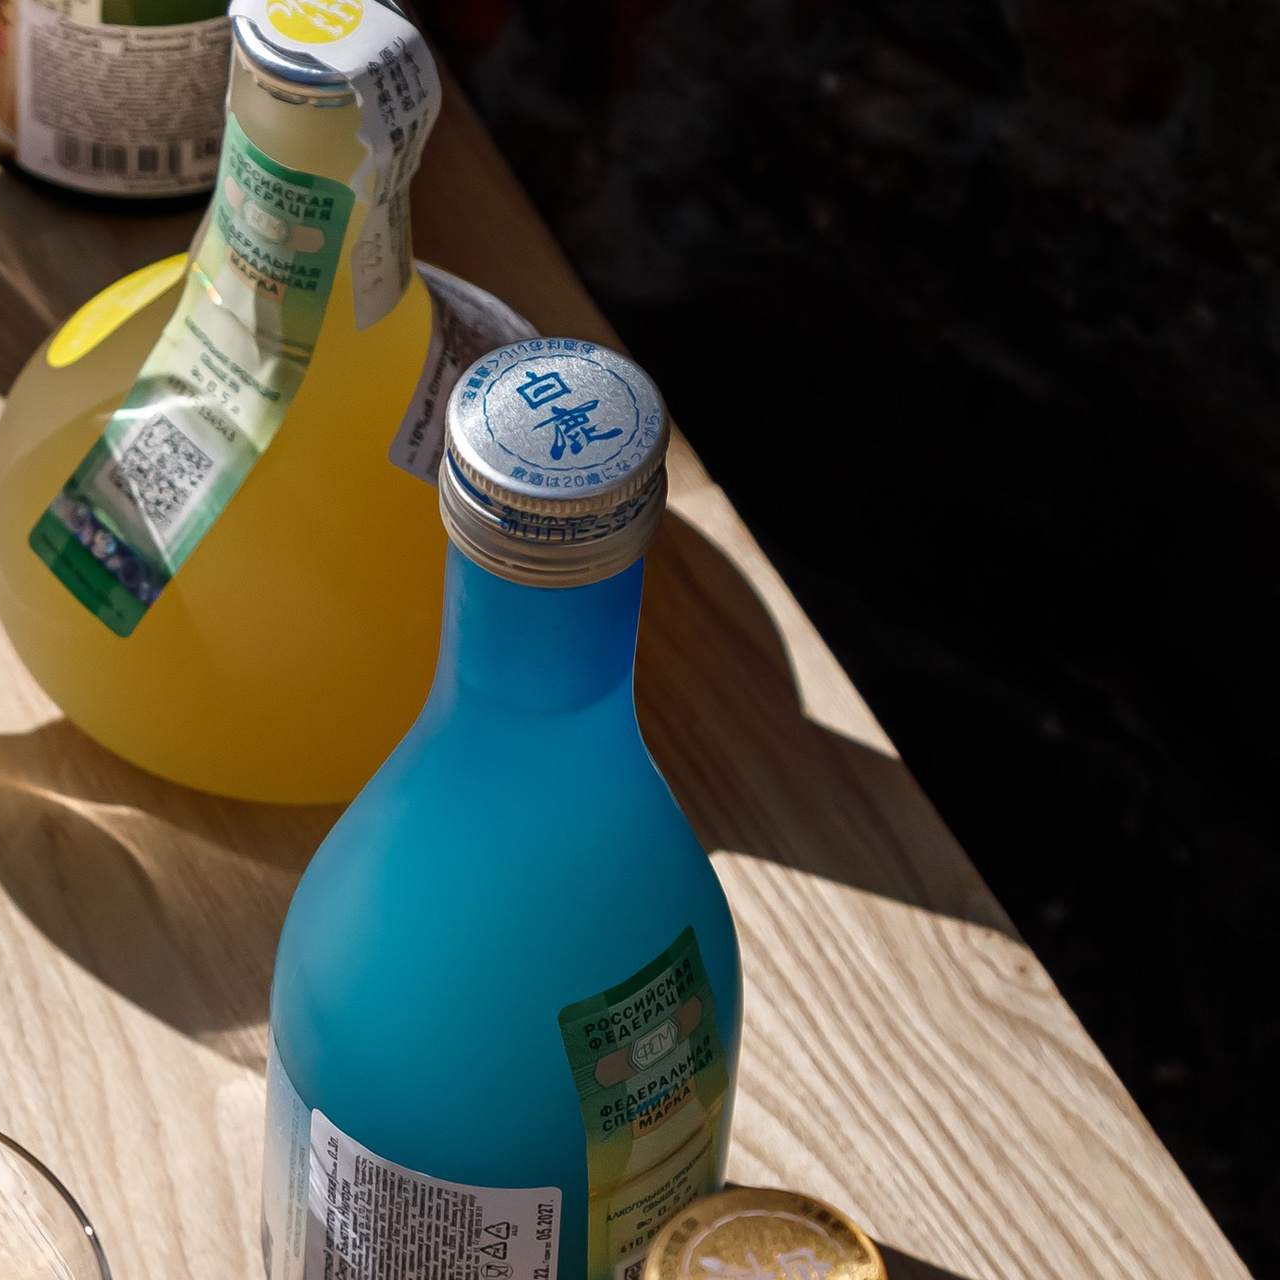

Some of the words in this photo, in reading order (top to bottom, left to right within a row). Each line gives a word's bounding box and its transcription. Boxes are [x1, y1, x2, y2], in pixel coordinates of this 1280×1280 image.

[517, 371, 623, 460] 白鹿
[585, 958, 692, 1038] РОССИЙСКАЯ
[588, 973, 695, 1050] ФЕДЕРАЦИЯ
[600, 1035, 711, 1117] ФЕДЕРАЛЬНАЯ
[639, 1086, 691, 1130] МАРКА
[606, 1181, 670, 1223] АЛКОГОЛЬНАЯ
